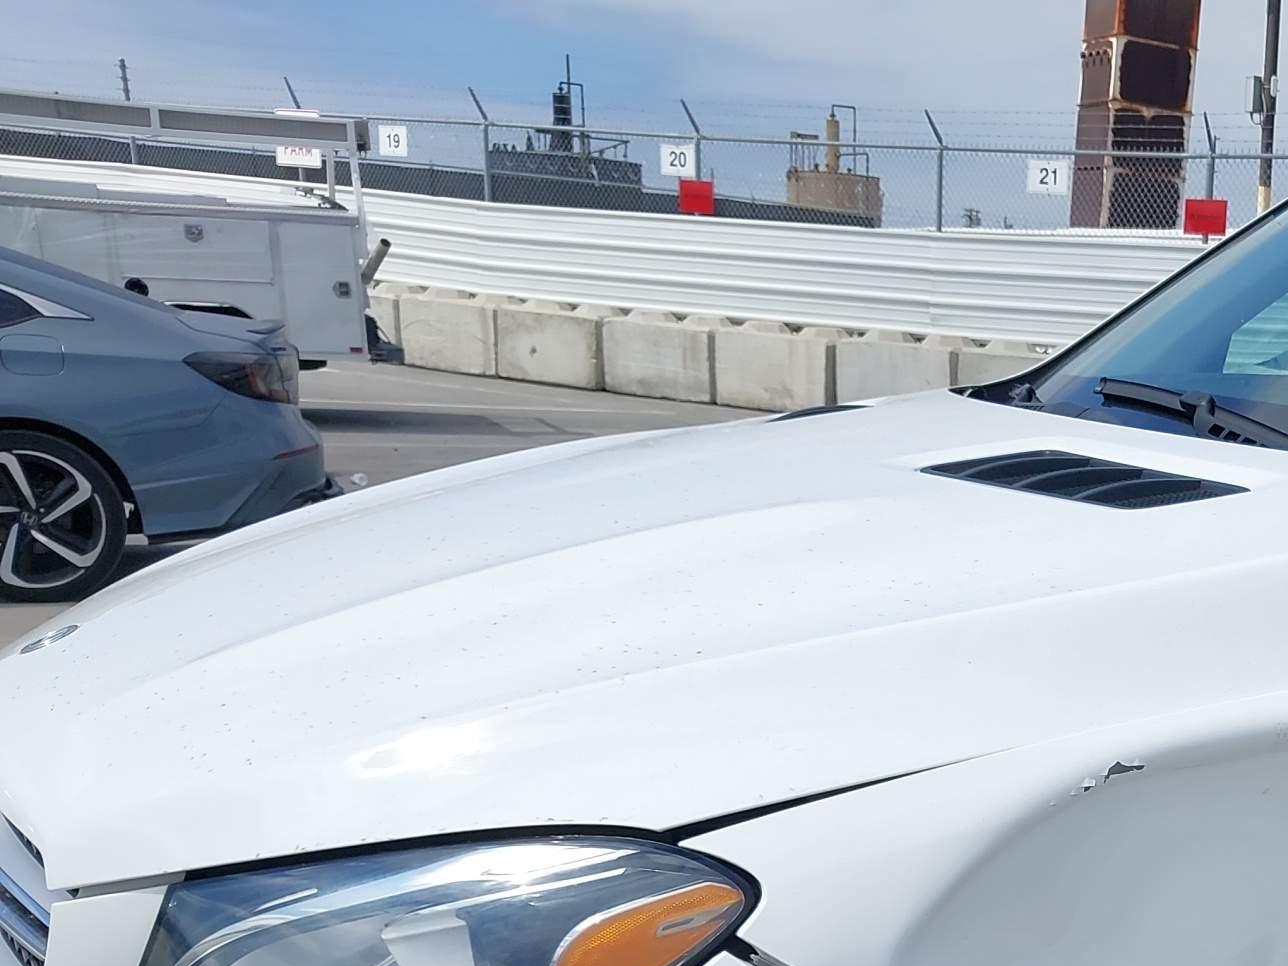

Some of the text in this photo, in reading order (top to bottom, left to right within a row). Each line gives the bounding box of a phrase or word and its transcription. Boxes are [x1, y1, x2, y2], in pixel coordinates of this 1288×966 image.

[386, 133, 401, 149] 19
[669, 150, 688, 168] 20
[1039, 167, 1058, 185] 21
